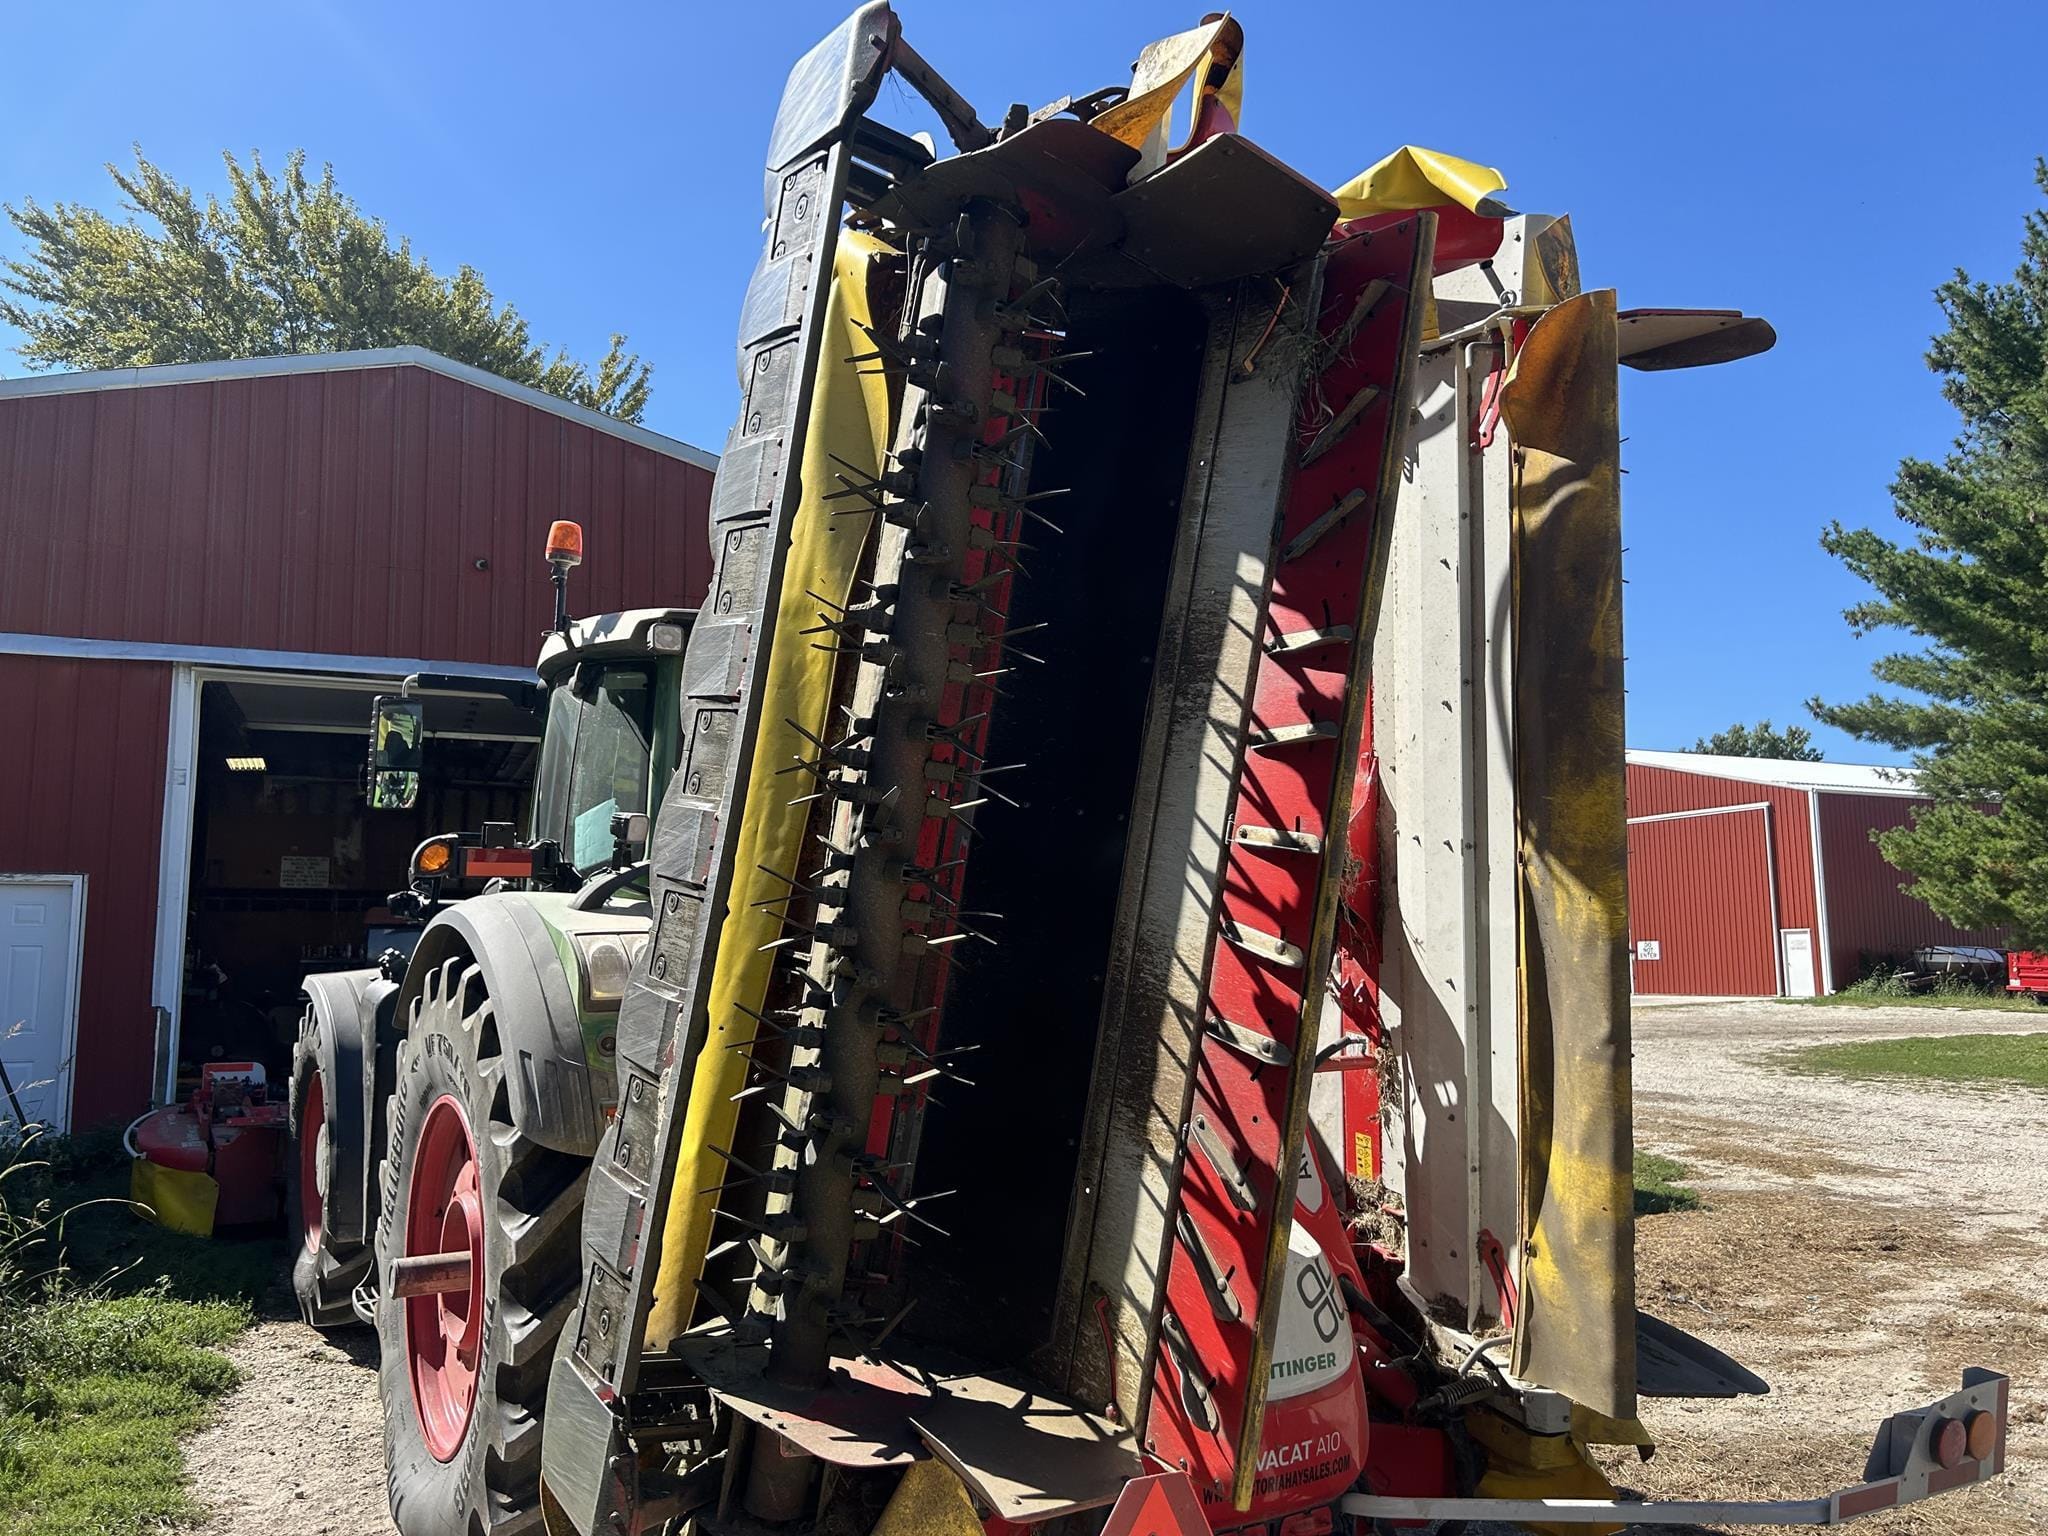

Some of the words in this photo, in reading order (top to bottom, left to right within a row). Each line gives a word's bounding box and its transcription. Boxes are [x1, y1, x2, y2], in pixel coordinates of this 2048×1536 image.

[1271, 1352, 1336, 1379] TTINGER
[1256, 1440, 1313, 1472] VACAT
[1316, 1431, 1341, 1457] A10
